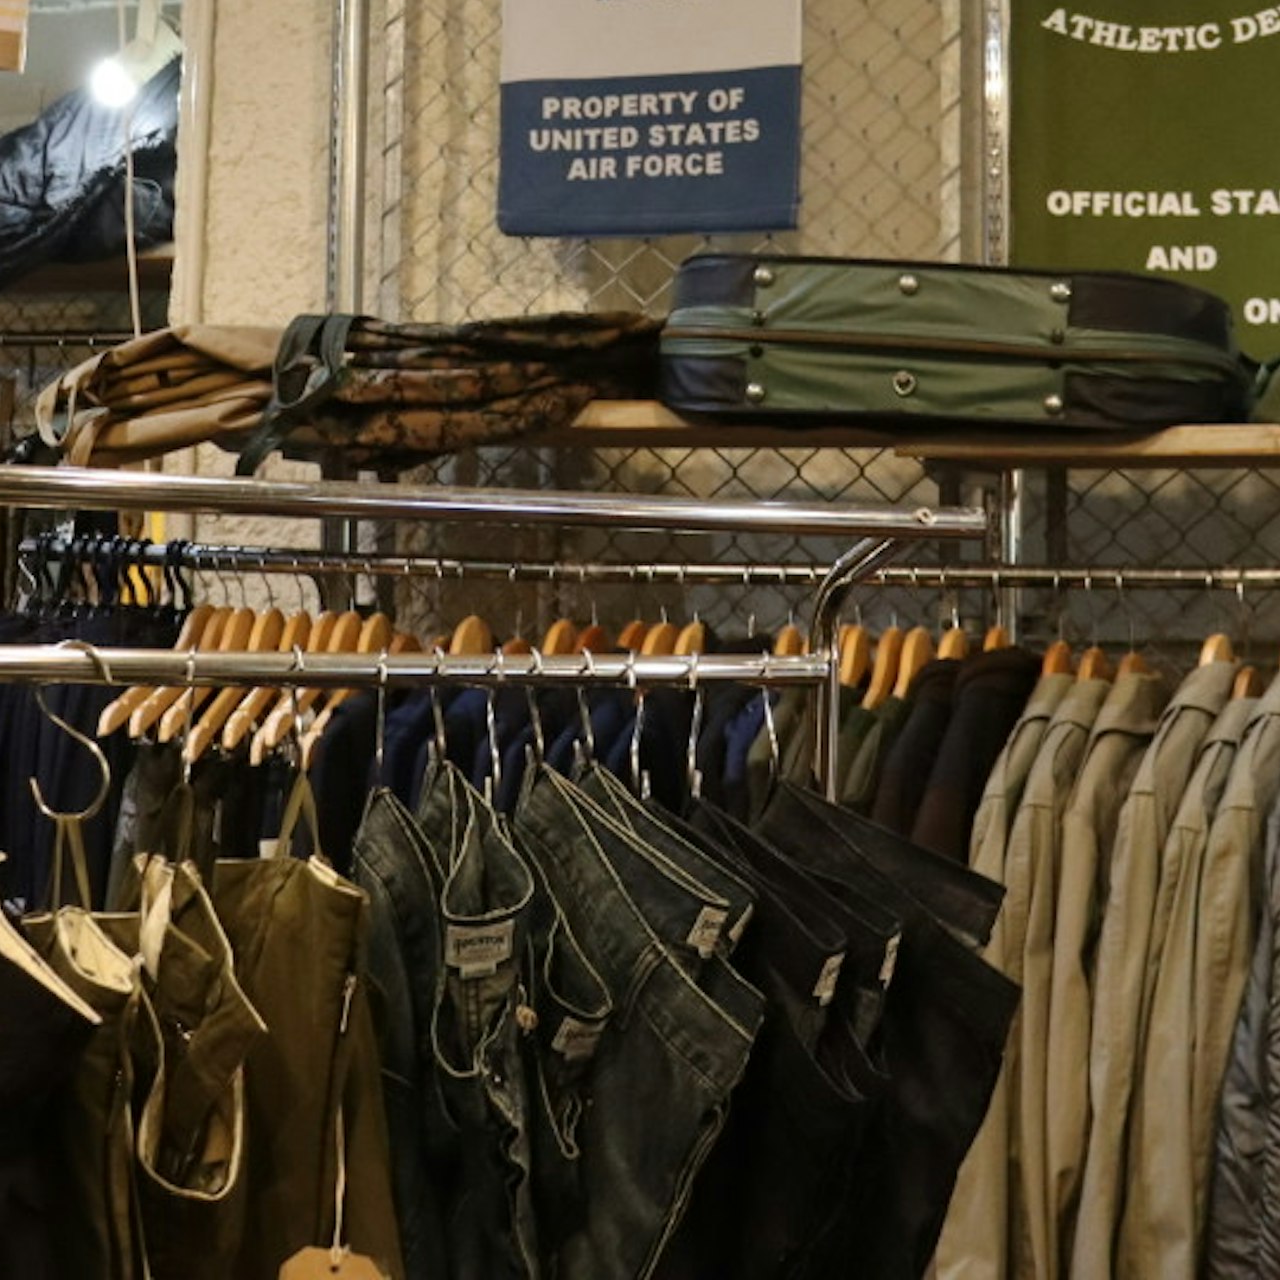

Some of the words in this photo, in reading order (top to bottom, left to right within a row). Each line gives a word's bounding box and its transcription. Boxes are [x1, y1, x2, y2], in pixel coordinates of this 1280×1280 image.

[1041, 6, 1222, 53] ATHLETIC
[542, 91, 698, 118] PROPERTY
[708, 87, 745, 111] OF
[529, 127, 640, 150] UNITED
[648, 120, 760, 146] STATES
[567, 156, 618, 181] AIR
[626, 152, 724, 177] FORCE
[1046, 189, 1201, 217] OFFICIAL
[1145, 245, 1217, 271] AND
